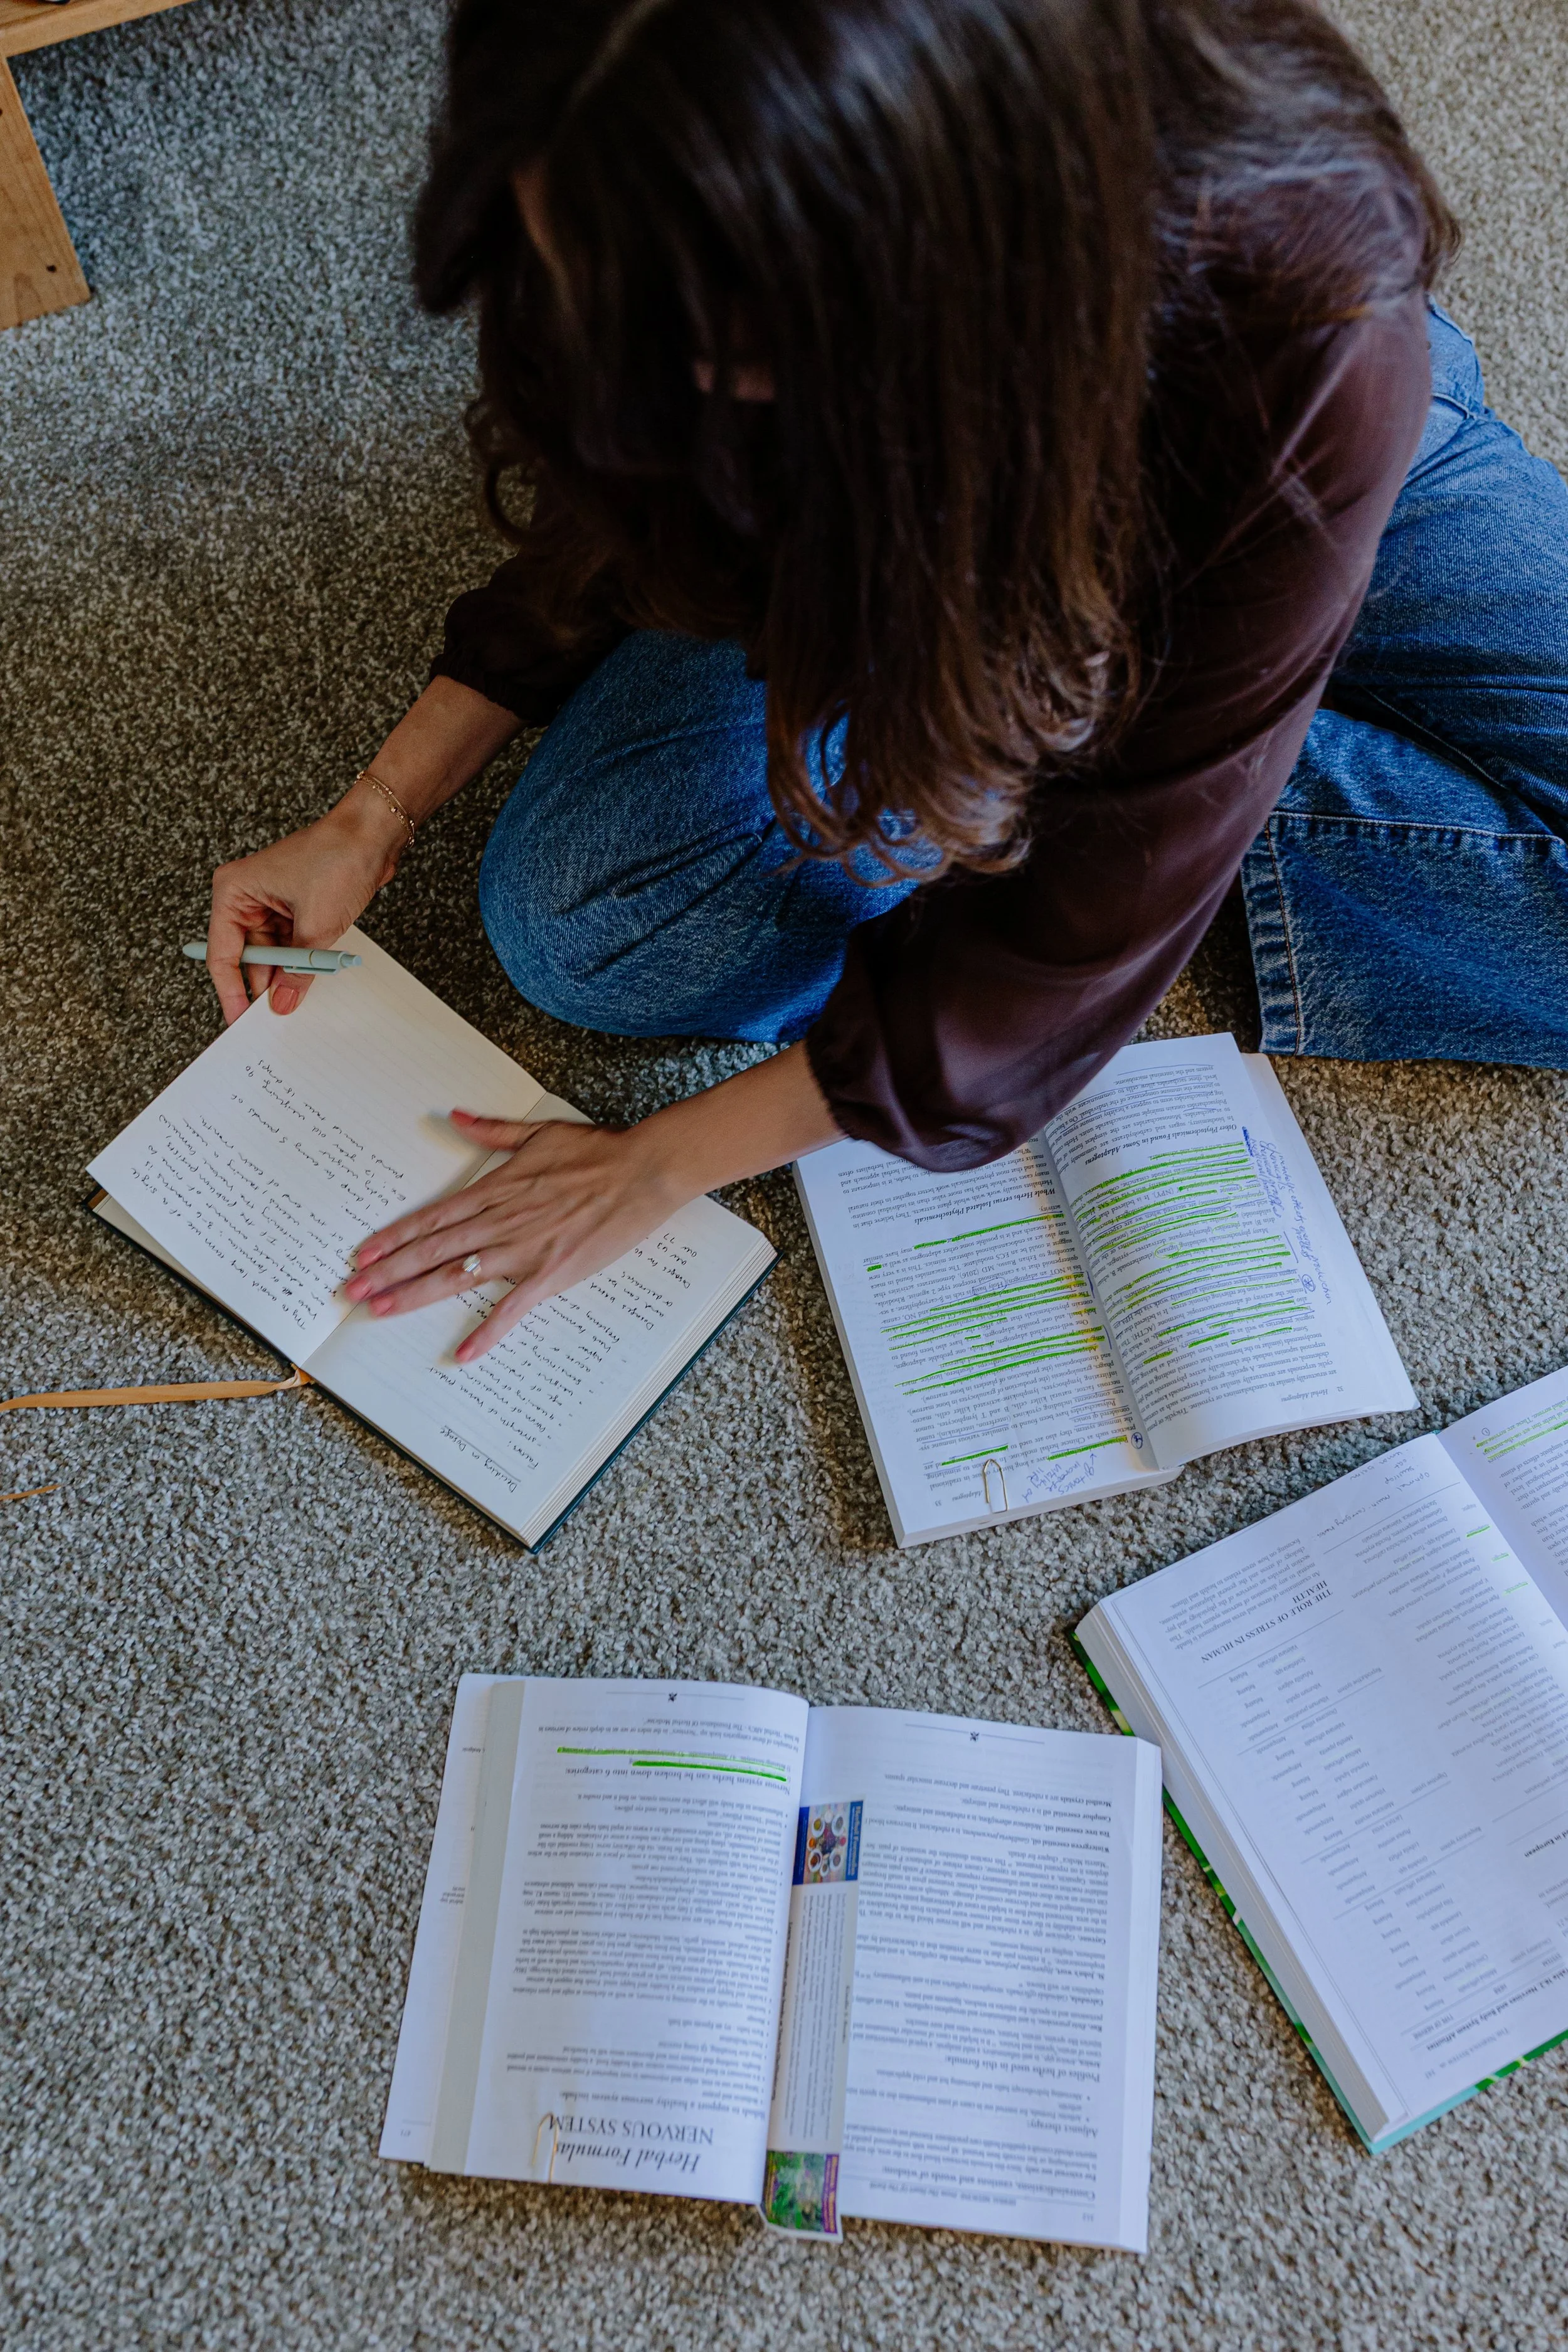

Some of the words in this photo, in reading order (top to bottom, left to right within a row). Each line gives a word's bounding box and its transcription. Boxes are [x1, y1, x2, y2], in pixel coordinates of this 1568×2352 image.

[1186, 1098, 1227, 1110] Polysaccharides
[1141, 1108, 1164, 1116] multiple
[1094, 1112, 1140, 1130] monosaccharide
[1172, 1125, 1217, 1139] Phytochemicals
[1063, 1135, 1078, 1147] Herbs
[1150, 1133, 1170, 1143] Found
[1122, 1140, 1140, 1148] Some
[1085, 1145, 1120, 1165] Adaptogens
[267, 1179, 279, 1187] of
[1024, 1179, 1052, 1188] Herbalists
[985, 1189, 1001, 1197] work
[1002, 1184, 1022, 1194] usually
[1034, 1187, 1055, 1197] Whole
[992, 1195, 1012, 1204] versus
[1014, 1191, 1032, 1200] Herbs
[936, 1199, 951, 1209] plant
[953, 1197, 970, 1209] whole
[965, 1200, 991, 1213] Isolated
[874, 1215, 894, 1223] believe
[914, 1207, 963, 1225] Phytochemicals
[1046, 1247, 1075, 1258] according
[981, 1264, 995, 1273] MD
[916, 1274, 955, 1287] demonstrates
[887, 1285, 914, 1294] activities
[1083, 1370, 1118, 1380] infiltrating
[1281, 1392, 1309, 1401] Adaptogens
[1310, 1388, 1328, 1398] Herbal
[973, 1387, 1039, 1411] lymphokine-activated
[953, 1406, 970, 1414] killer
[911, 1415, 931, 1423] macro-
[1545, 1452, 1563, 1468] system
[1512, 1468, 1535, 1483] number
[1525, 1464, 1559, 1487] psychological
[1503, 1481, 1510, 1489] of
[1279, 1575, 1311, 1596] examination
[1292, 1580, 1327, 1603] HEALTH
[1315, 1589, 1331, 1602] THE
[1257, 1597, 1273, 1607] stress
[1272, 1593, 1279, 1601] of
[1246, 1604, 1256, 1614] and
[1291, 1599, 1312, 1615] ROLE
[1231, 1611, 1247, 1621] stress
[1277, 1613, 1288, 1622] OF
[1197, 1618, 1231, 1639] management
[1245, 1621, 1276, 1638] STRESS
[1174, 1638, 1193, 1650] funda-
[1234, 1635, 1245, 1643] IN
[1201, 1641, 1233, 1661] HUMAN
[1278, 1644, 1298, 1657] Valeriana
[1257, 1654, 1278, 1668] officinalis
[1228, 1671, 1248, 1683] Relaxing
[605, 1769, 610, 1777] 6
[630, 1769, 652, 1779] down
[654, 1771, 681, 1780] broken
[684, 1772, 693, 1781] be
[712, 1774, 734, 1784] herbs
[736, 1777, 762, 1786] system
[765, 1781, 790, 1795] Nervous
[549, 2114, 615, 2133] SYSTEM
[623, 2121, 712, 2143] NERVOUS
[635, 2149, 699, 2171] Herbal
